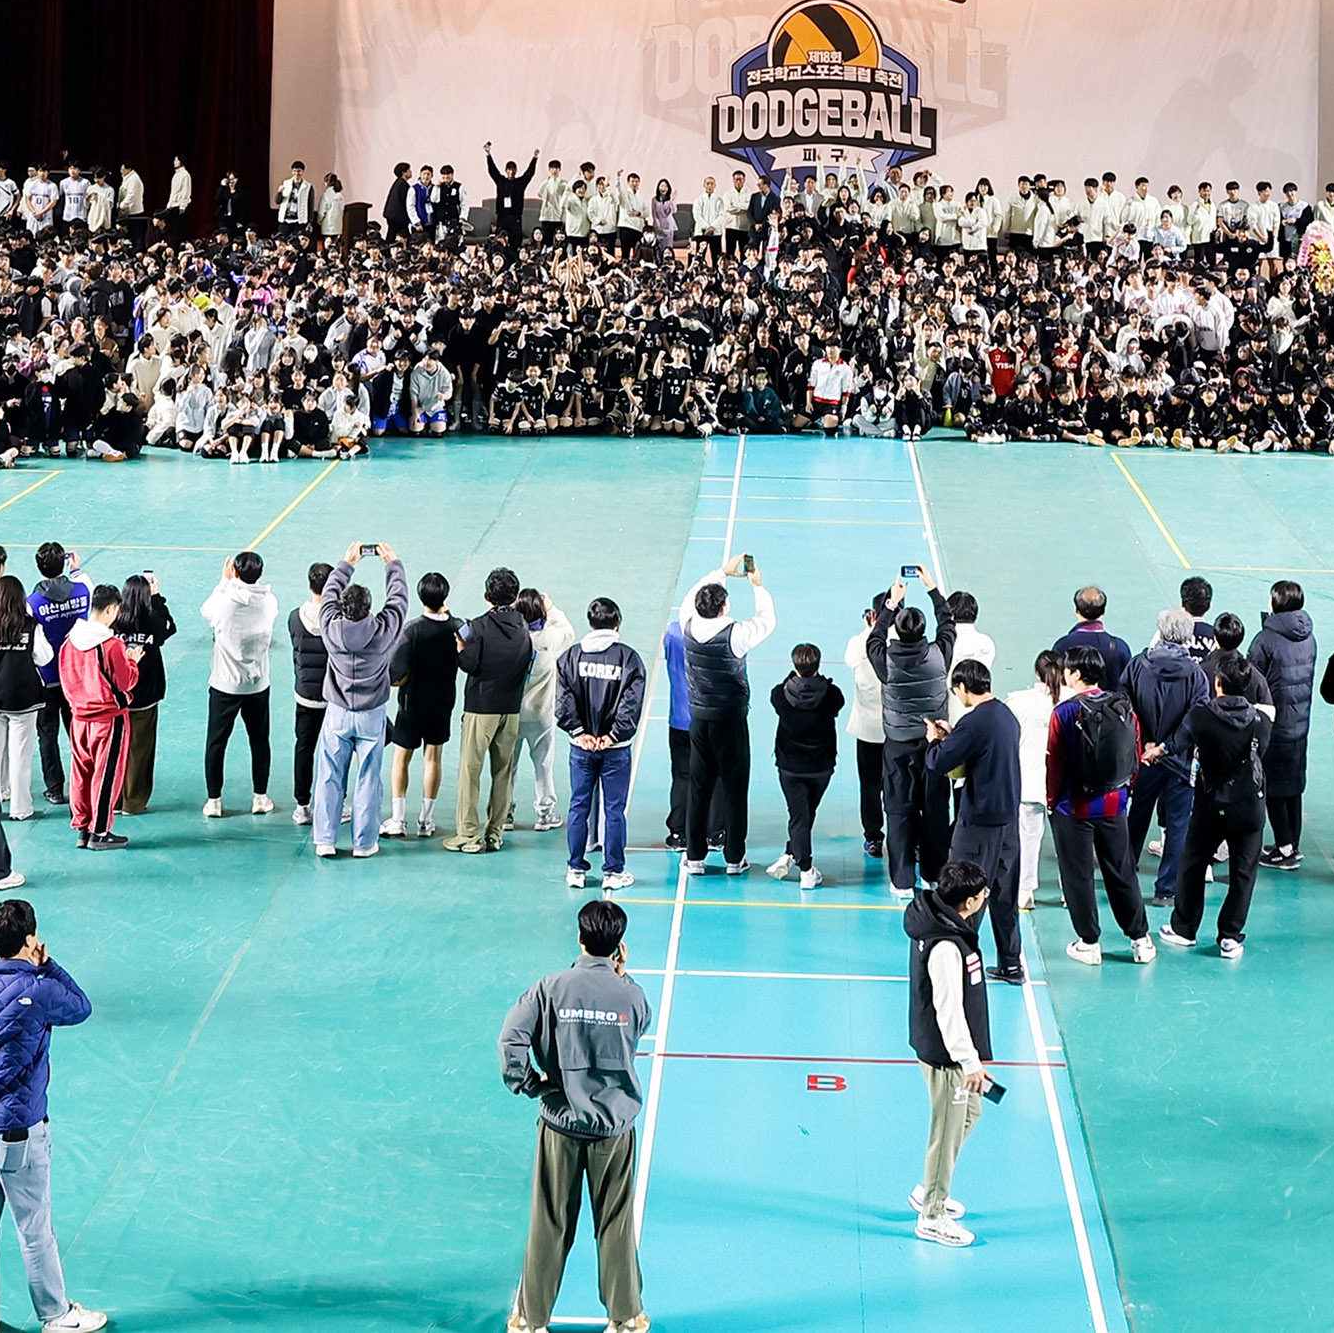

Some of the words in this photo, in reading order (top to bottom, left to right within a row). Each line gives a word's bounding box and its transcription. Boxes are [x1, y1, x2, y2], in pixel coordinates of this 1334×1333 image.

[807, 50, 842, 65] 제18회
[746, 65, 872, 87] 전국학교스포츠클럽
[874, 70, 903, 89] 축전
[716, 88, 932, 149] DODGEBALL
[670, 385, 681, 395] 12
[578, 661, 622, 681] KOREA
[558, 1008, 618, 1021] UMBRO
[807, 1075, 847, 1091] B
